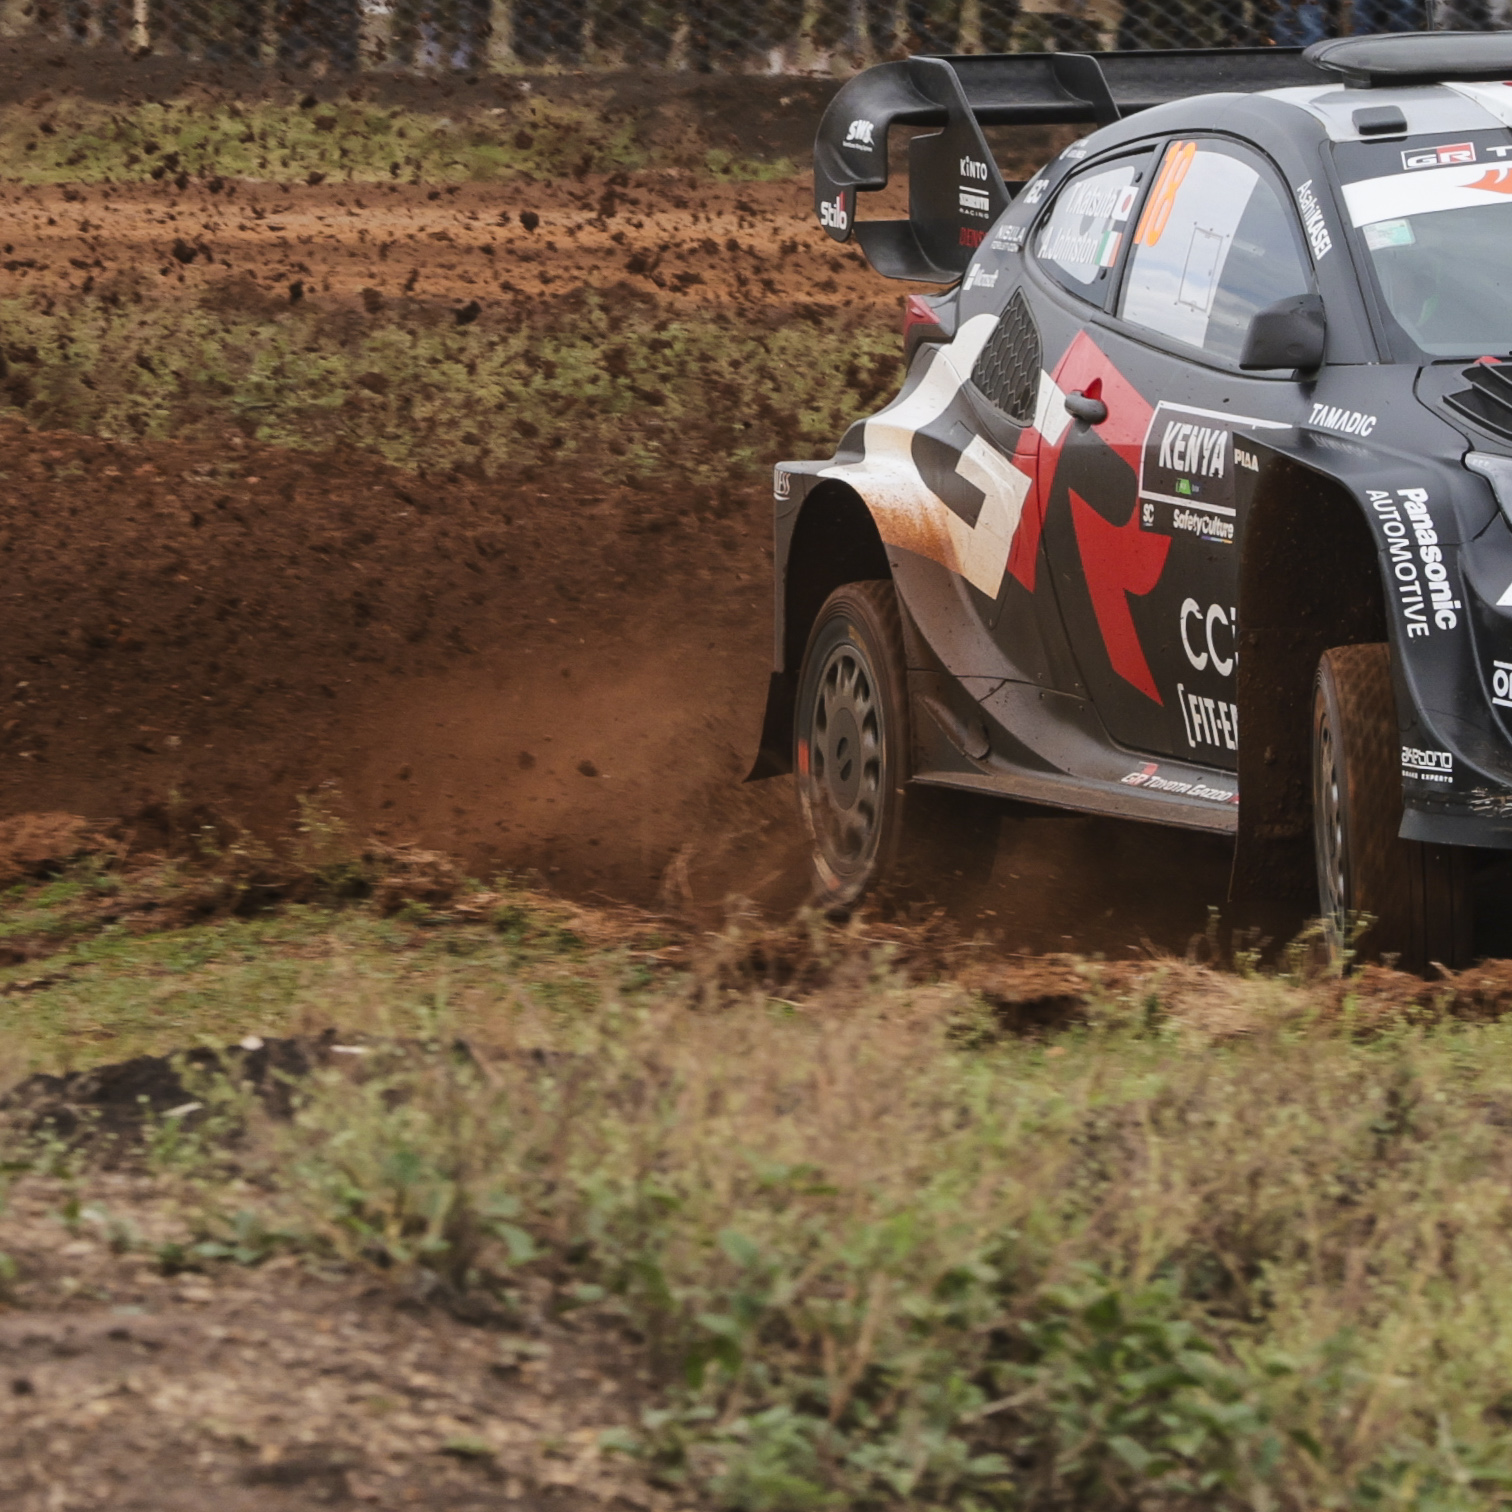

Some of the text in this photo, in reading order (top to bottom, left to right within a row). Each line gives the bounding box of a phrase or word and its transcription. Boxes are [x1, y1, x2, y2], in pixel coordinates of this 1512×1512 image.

[1406, 150, 1473, 168] GR
[820, 191, 847, 230] Stilo
[1133, 140, 1197, 247] 18
[1296, 179, 1332, 261] AsahiKASEI
[1308, 402, 1377, 437] TAMADIC
[1158, 421, 1229, 478] KENYA
[1234, 448, 1259, 472] PIAA
[1142, 503, 1155, 523] SC
[1173, 508, 1235, 538] SafetyCulture
[1365, 489, 1430, 639] AUTOMOTIVE
[1397, 487, 1462, 631] Panasonic
[1401, 745, 1453, 769] akebono
[1143, 775, 1193, 794] TOYOTA
[1187, 784, 1233, 802] GAZOO
